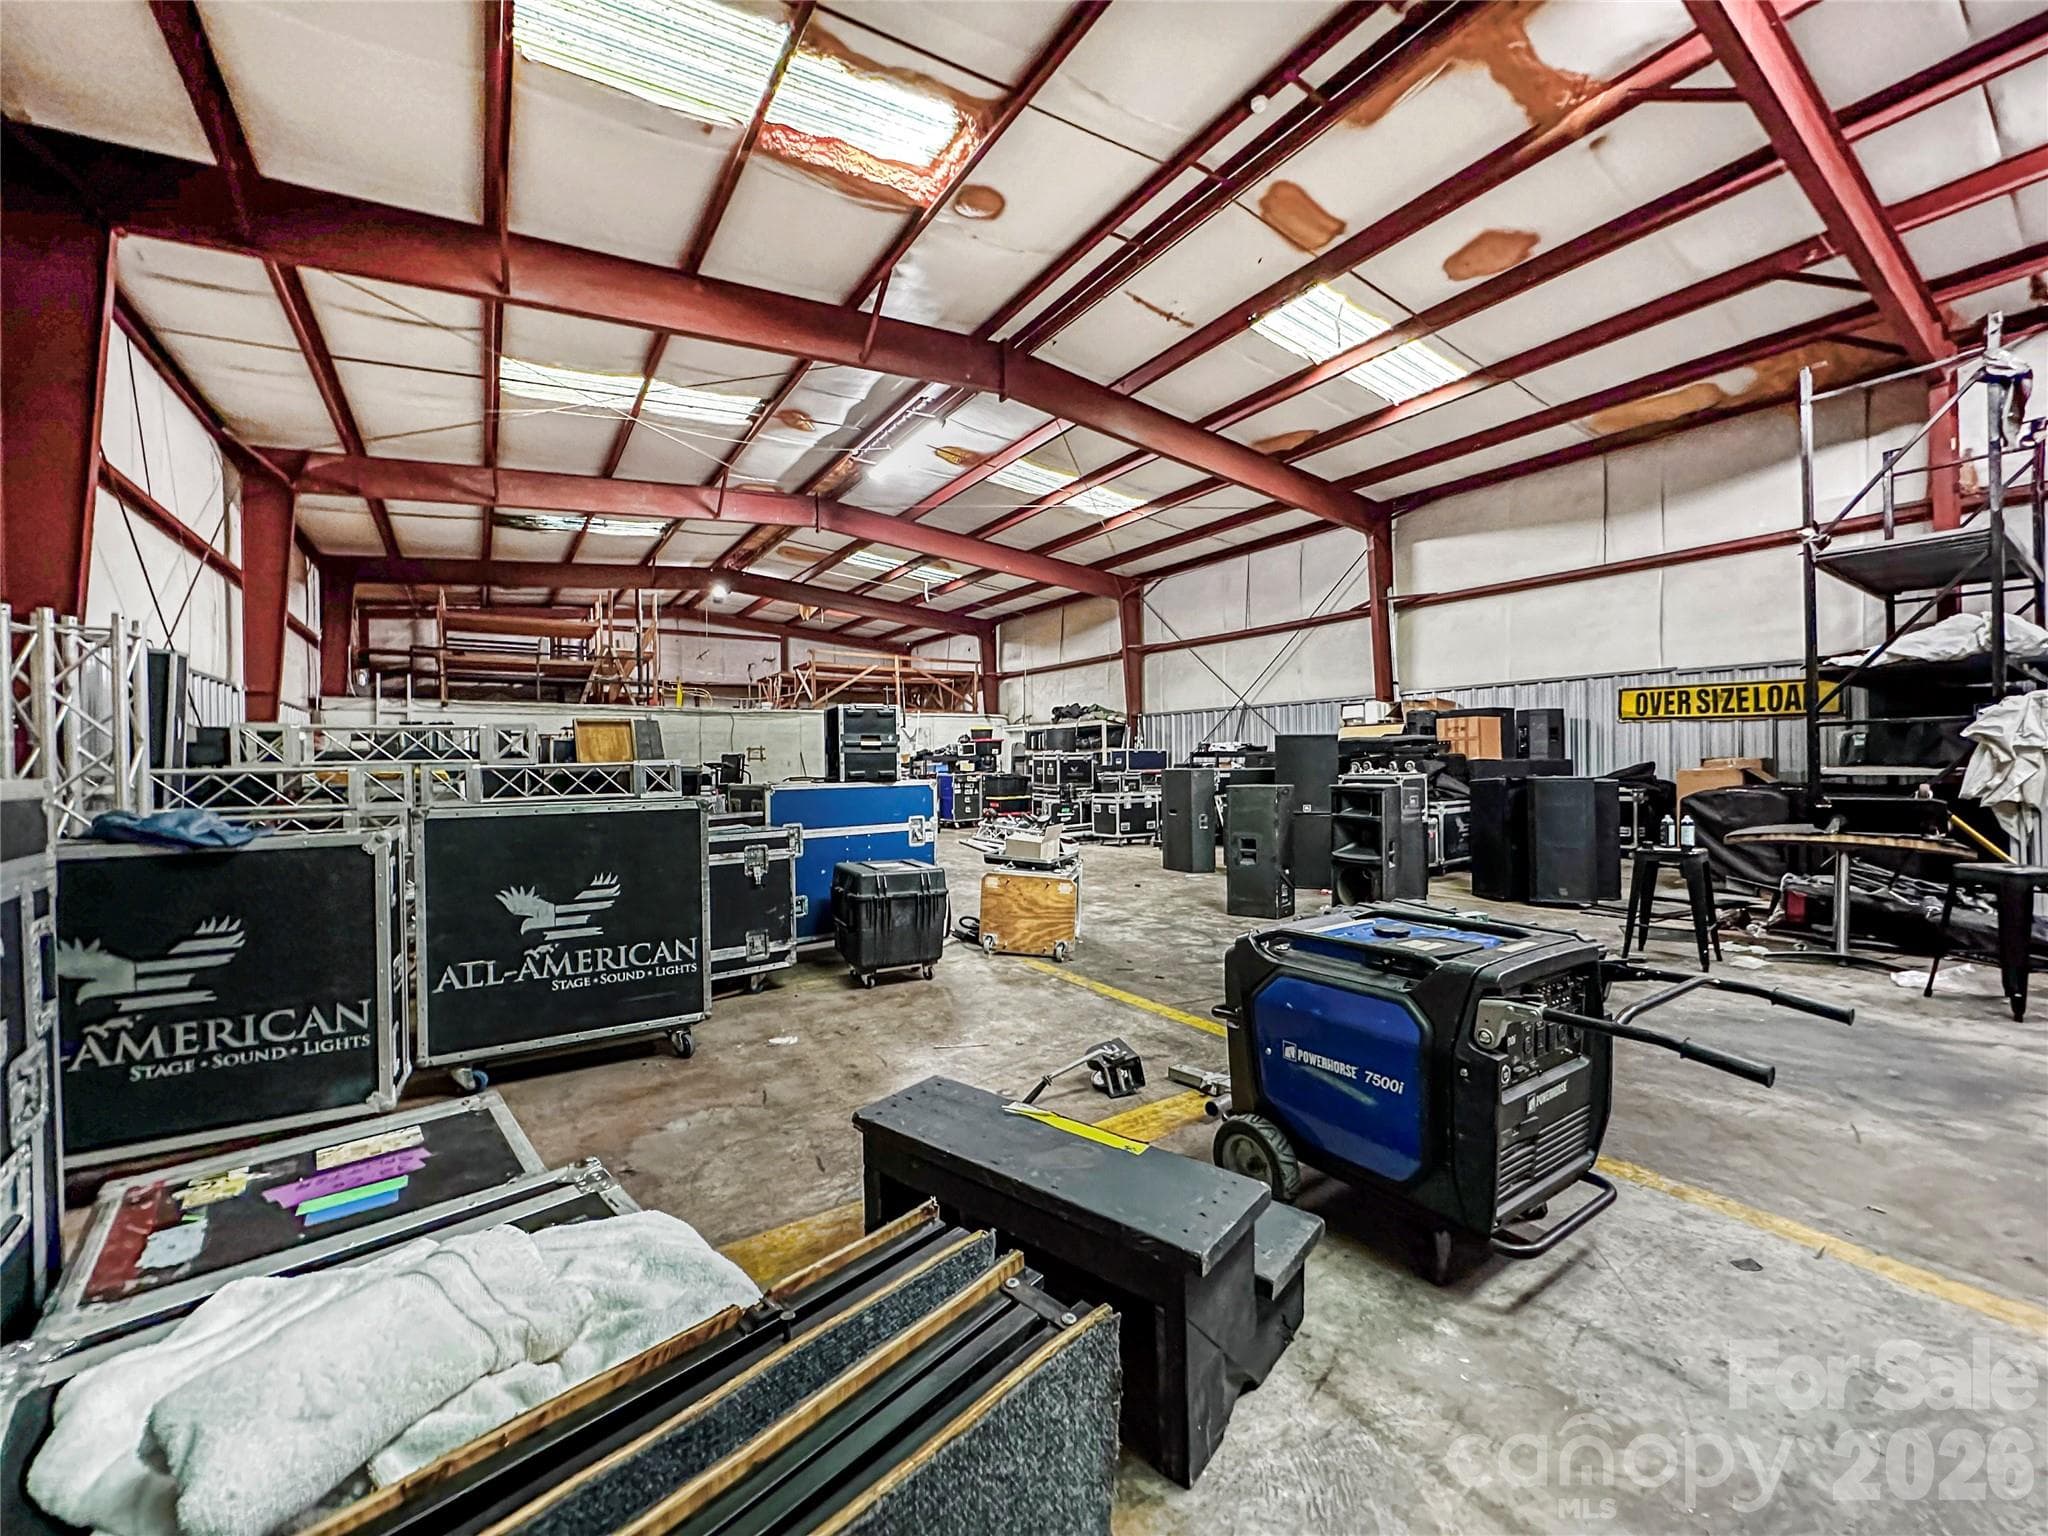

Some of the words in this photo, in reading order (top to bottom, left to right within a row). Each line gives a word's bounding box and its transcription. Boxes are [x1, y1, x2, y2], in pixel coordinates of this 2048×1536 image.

[1635, 689, 1691, 716] OVER
[1696, 686, 1750, 714] SIZE
[1754, 684, 1807, 712] LOA
[432, 937, 698, 993] ALL-AMERICAN
[552, 977, 591, 991] STAGE
[600, 970, 645, 985] SOUND
[655, 963, 697, 977] LIGHTS
[129, 1058, 196, 1082] STAGE
[212, 1047, 287, 1069] SOUND
[302, 1034, 371, 1056] LIGHTS
[1297, 1049, 1359, 1079] POWERHORSE
[1364, 1070, 1405, 1095] 7500i
